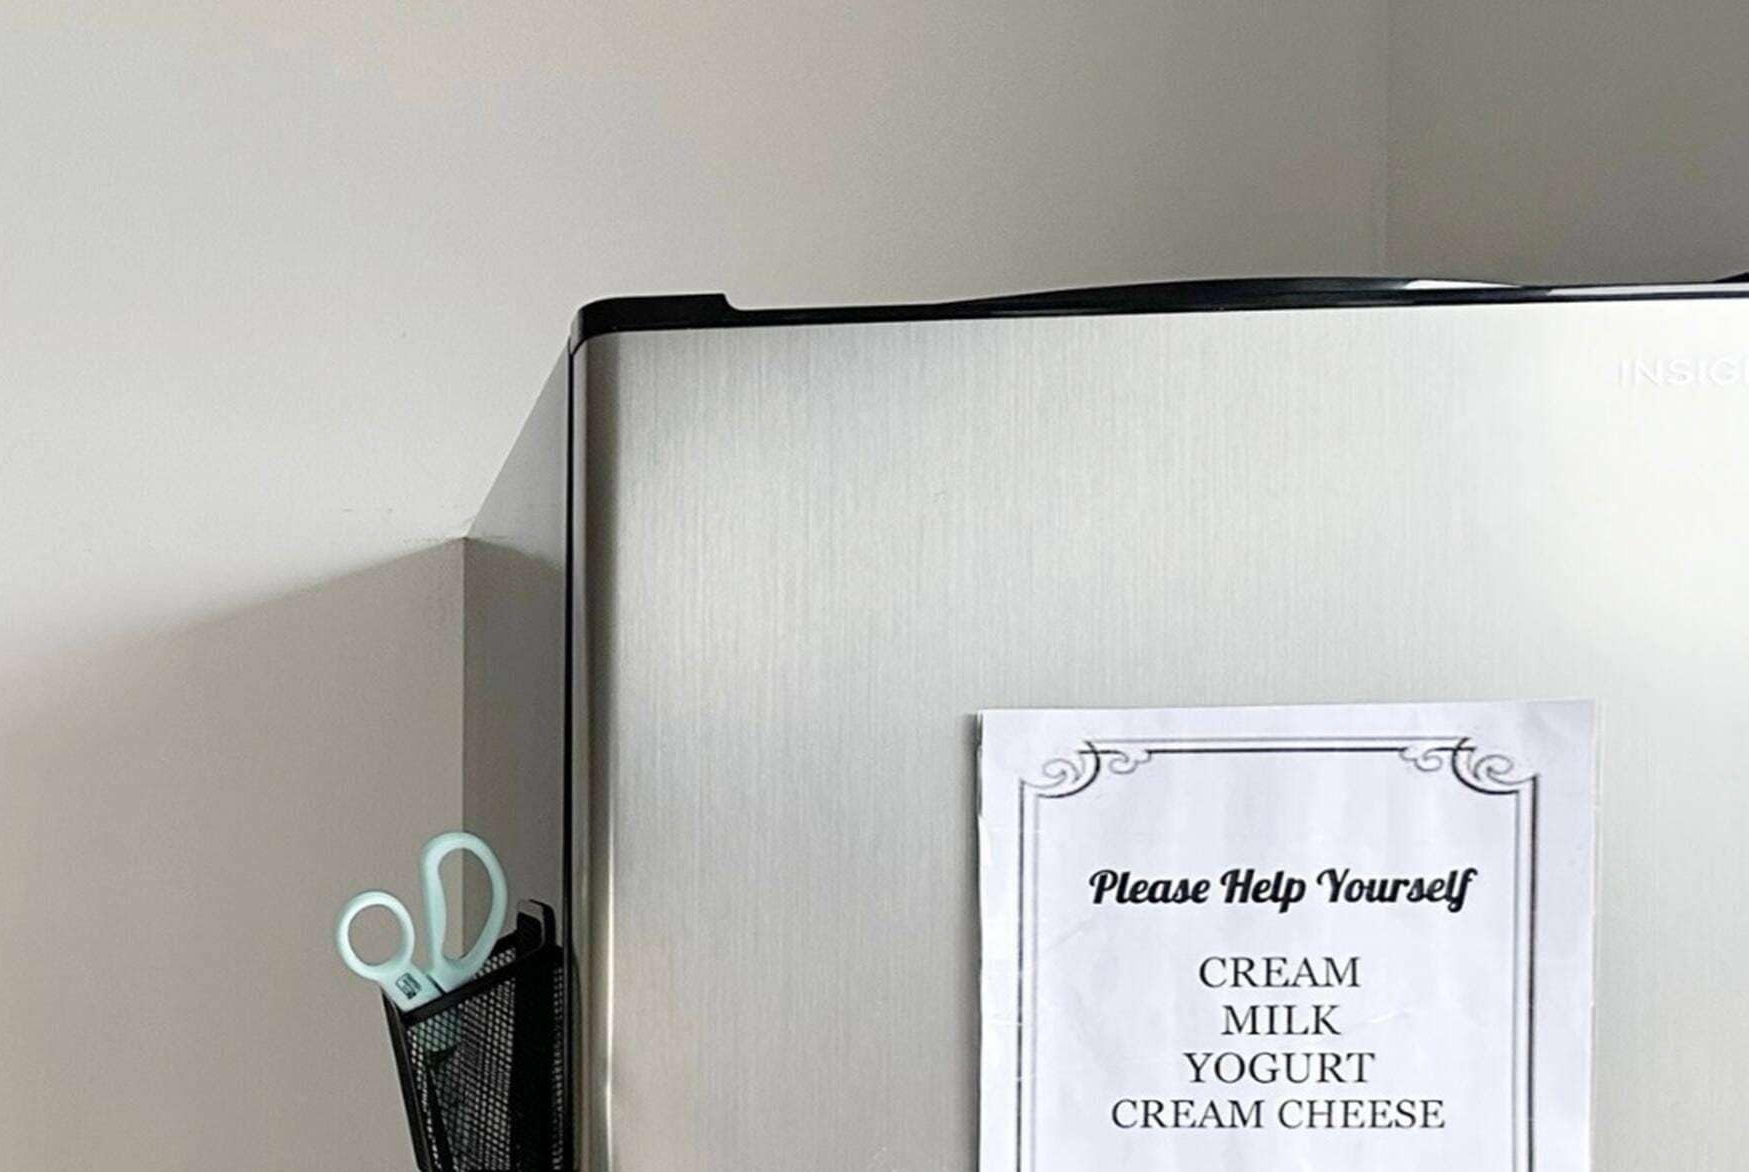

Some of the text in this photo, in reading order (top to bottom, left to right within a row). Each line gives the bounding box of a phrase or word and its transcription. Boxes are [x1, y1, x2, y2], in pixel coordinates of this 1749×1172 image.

[1619, 358, 1749, 386] INSIG
[1089, 867, 1478, 913] Please Help Yourself
[1198, 956, 1361, 988] CREAM
[1221, 1004, 1341, 1036] MILK
[1184, 1052, 1375, 1084] YOGURT
[1111, 1099, 1446, 1129] CREAM CHEESE
